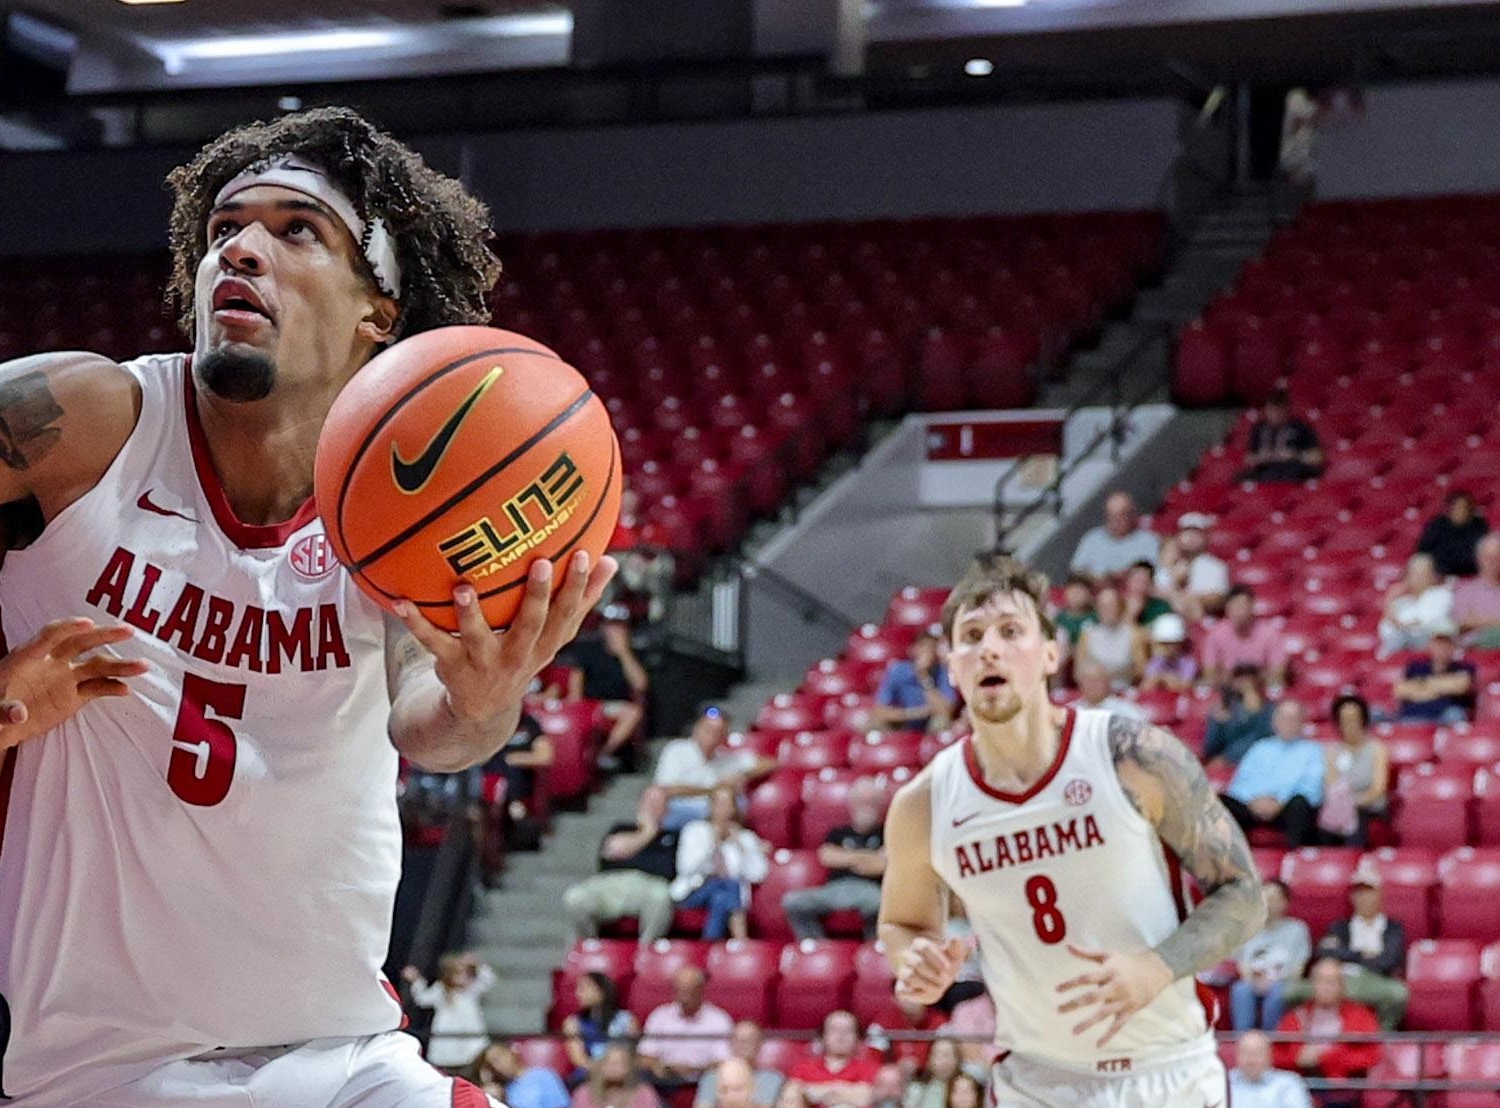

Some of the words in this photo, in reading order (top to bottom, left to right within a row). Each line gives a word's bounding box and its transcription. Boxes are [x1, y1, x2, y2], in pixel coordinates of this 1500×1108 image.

[85, 546, 351, 675] ALABAMA
[167, 671, 247, 807] 5
[955, 814, 1105, 878] ALABAMA
[1025, 874, 1067, 945] 8
